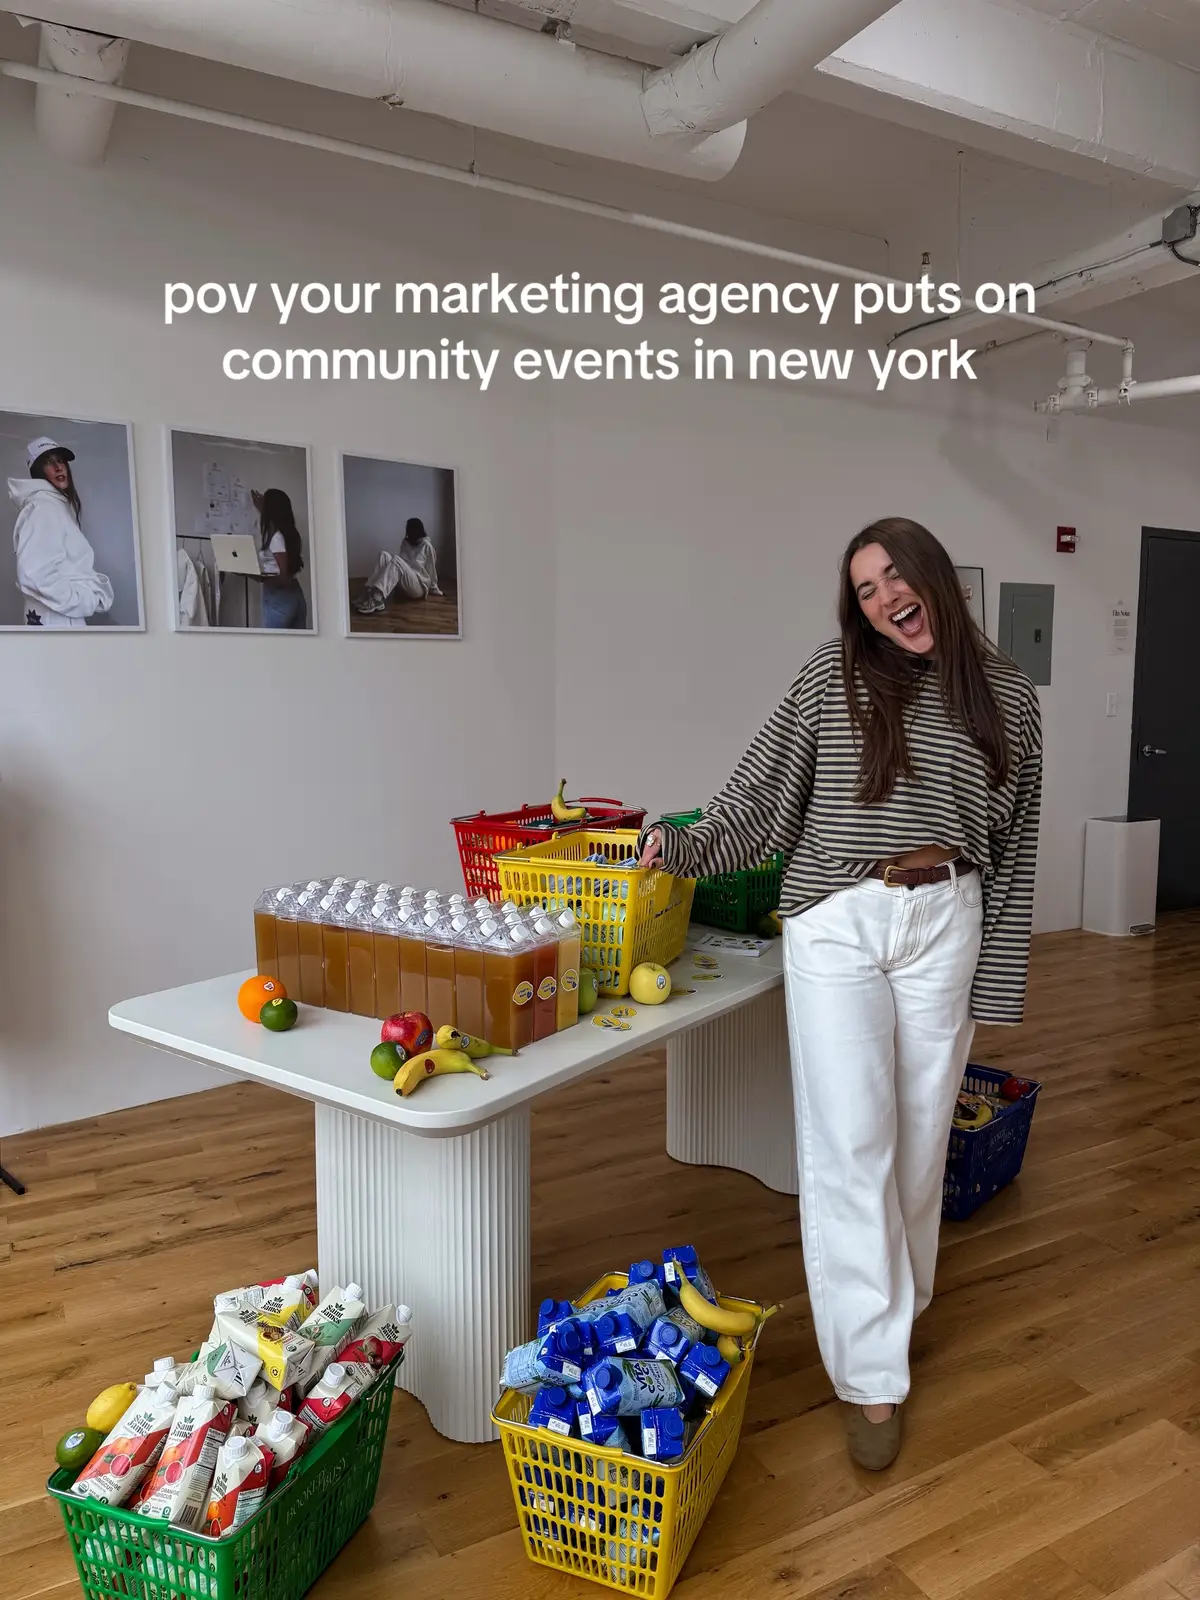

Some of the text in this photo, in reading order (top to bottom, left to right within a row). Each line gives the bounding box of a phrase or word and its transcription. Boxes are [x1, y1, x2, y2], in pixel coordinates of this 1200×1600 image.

[320, 1307, 342, 1325] James
[326, 1304, 344, 1318] Saint
[127, 1418, 151, 1439] James
[133, 1413, 154, 1432] Saint
[176, 1421, 194, 1433] Saint
[171, 1429, 193, 1440] James
